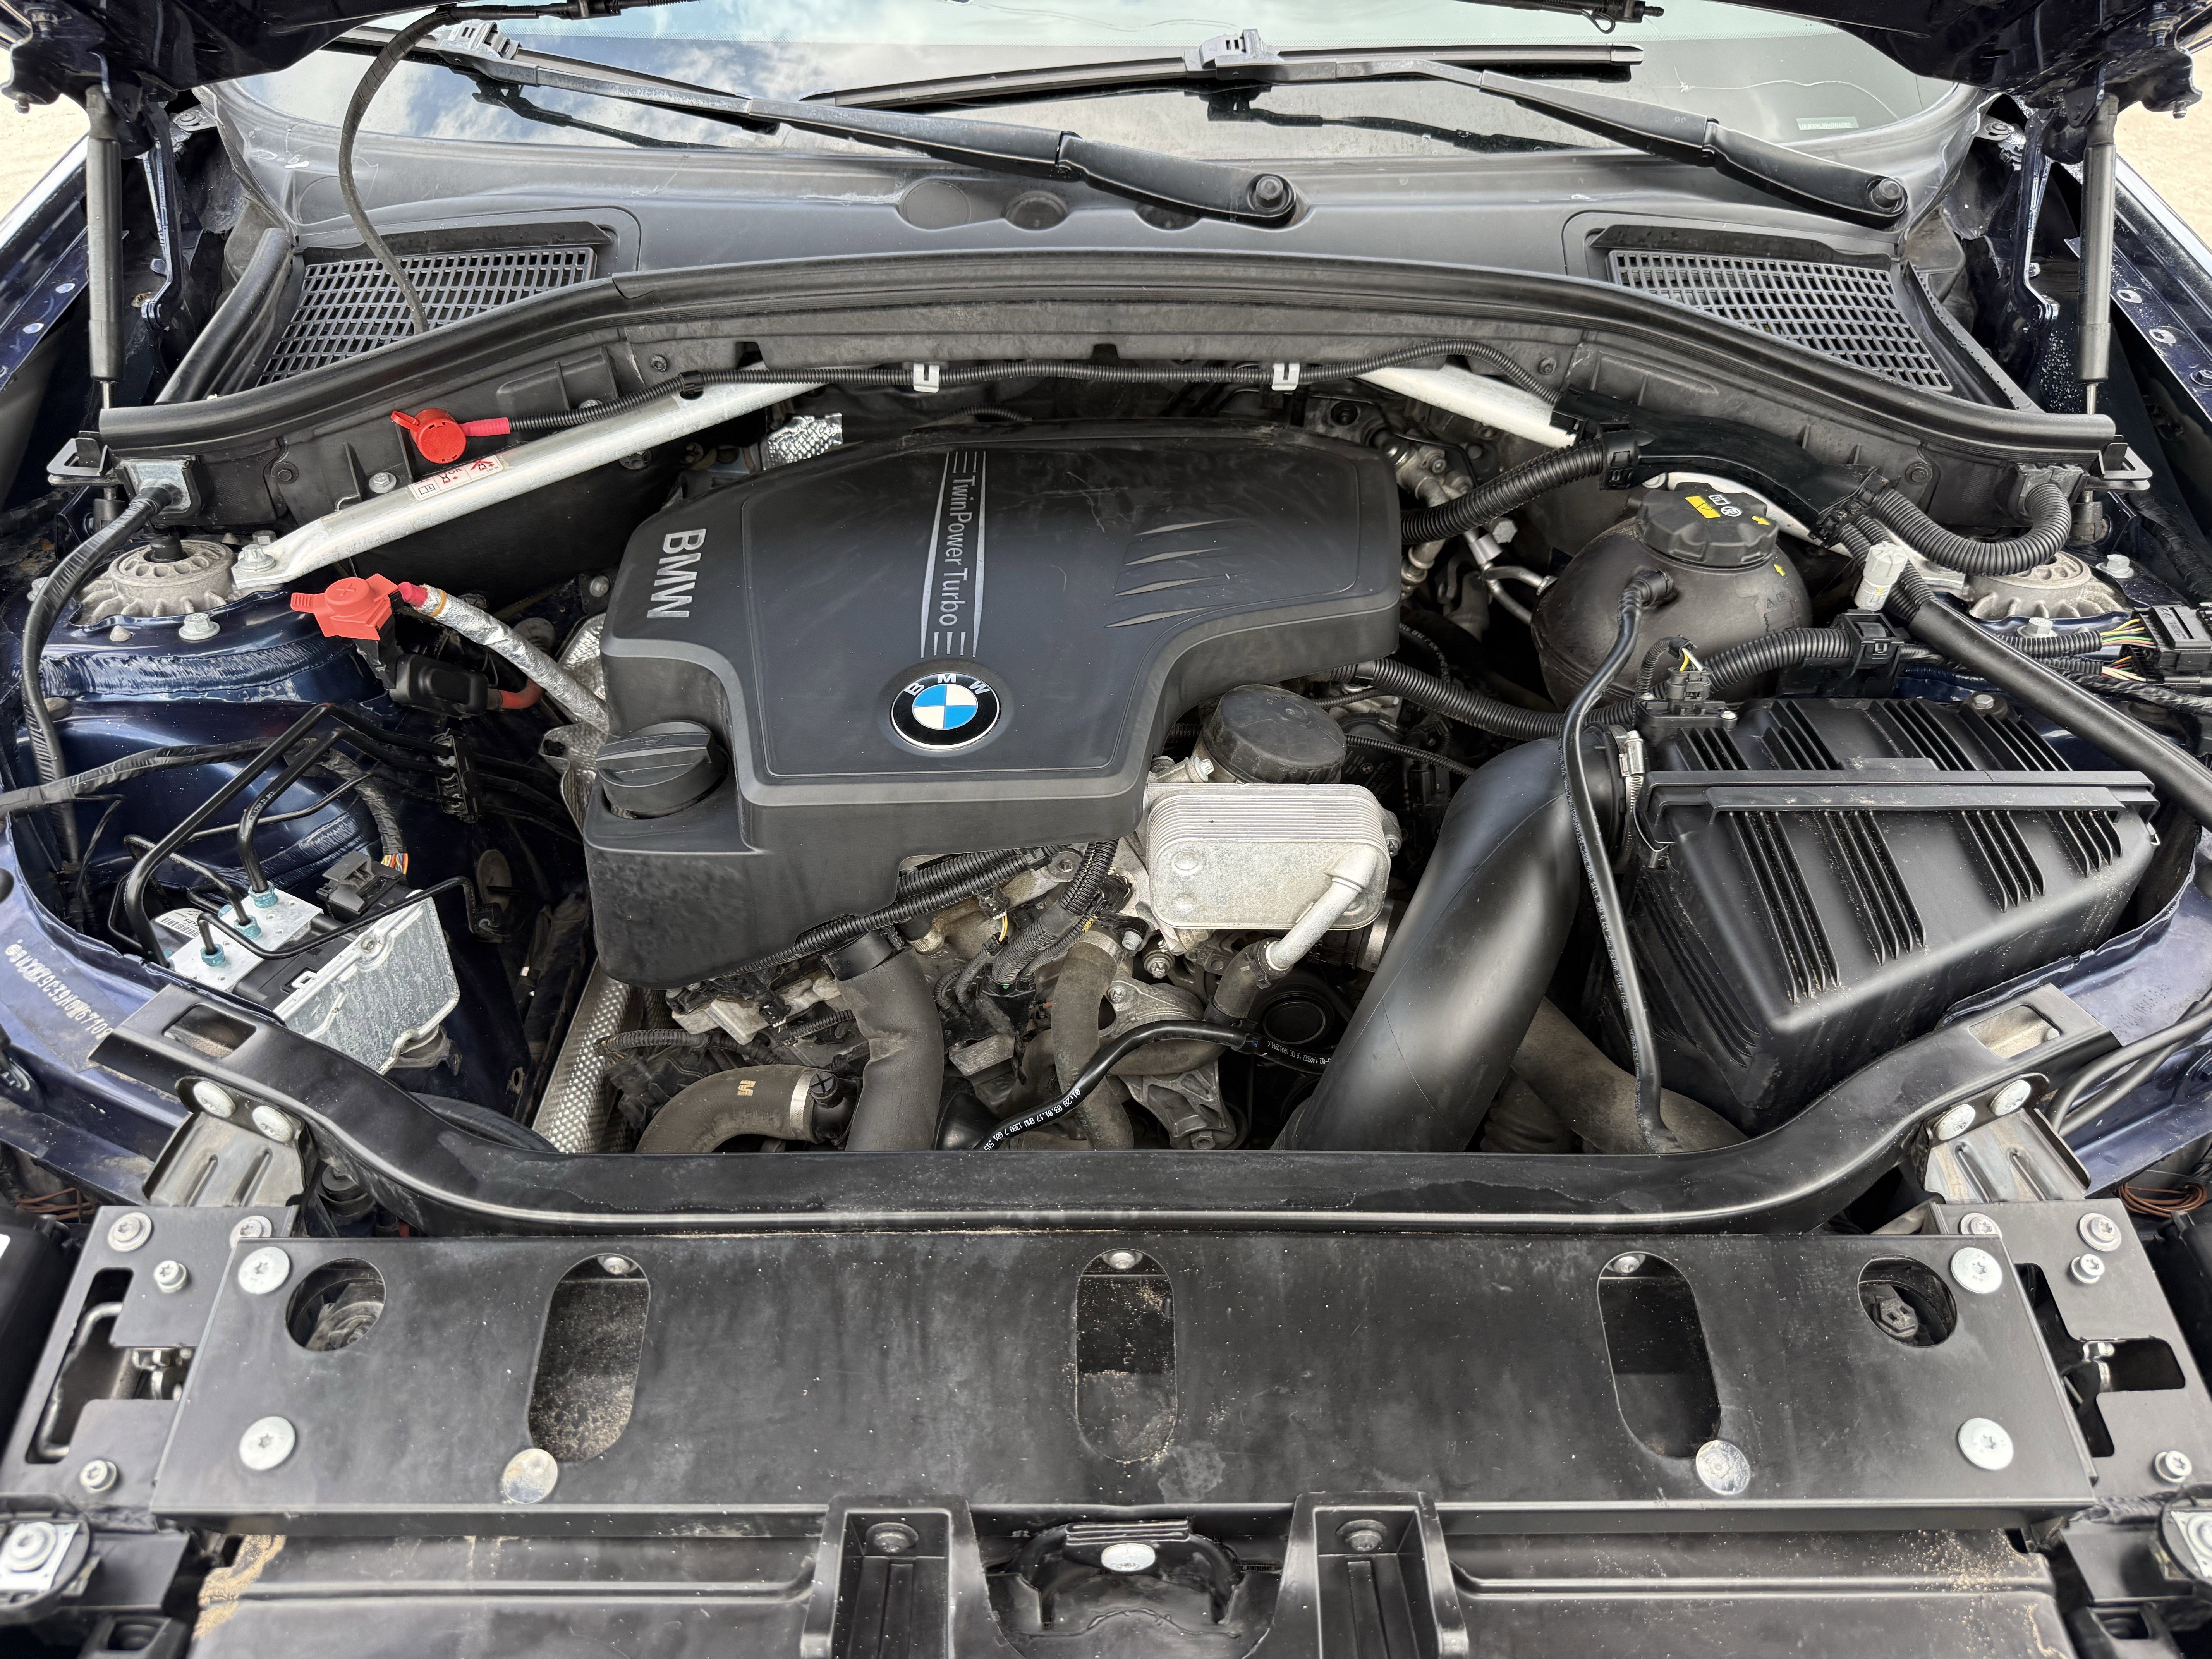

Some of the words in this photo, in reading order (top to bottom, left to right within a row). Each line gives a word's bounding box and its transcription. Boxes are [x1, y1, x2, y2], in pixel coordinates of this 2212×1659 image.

[945, 476, 975, 565] TwinPower
[647, 529, 707, 618] BMW
[939, 568, 968, 626] Turbo
[904, 673, 990, 696] BMW
[1063, 1089, 1081, 1107] 01:28
[1024, 1117, 1036, 1128] BMW
[1037, 1104, 1063, 1122] 03.01.17
[993, 1132, 1003, 1142] 601
